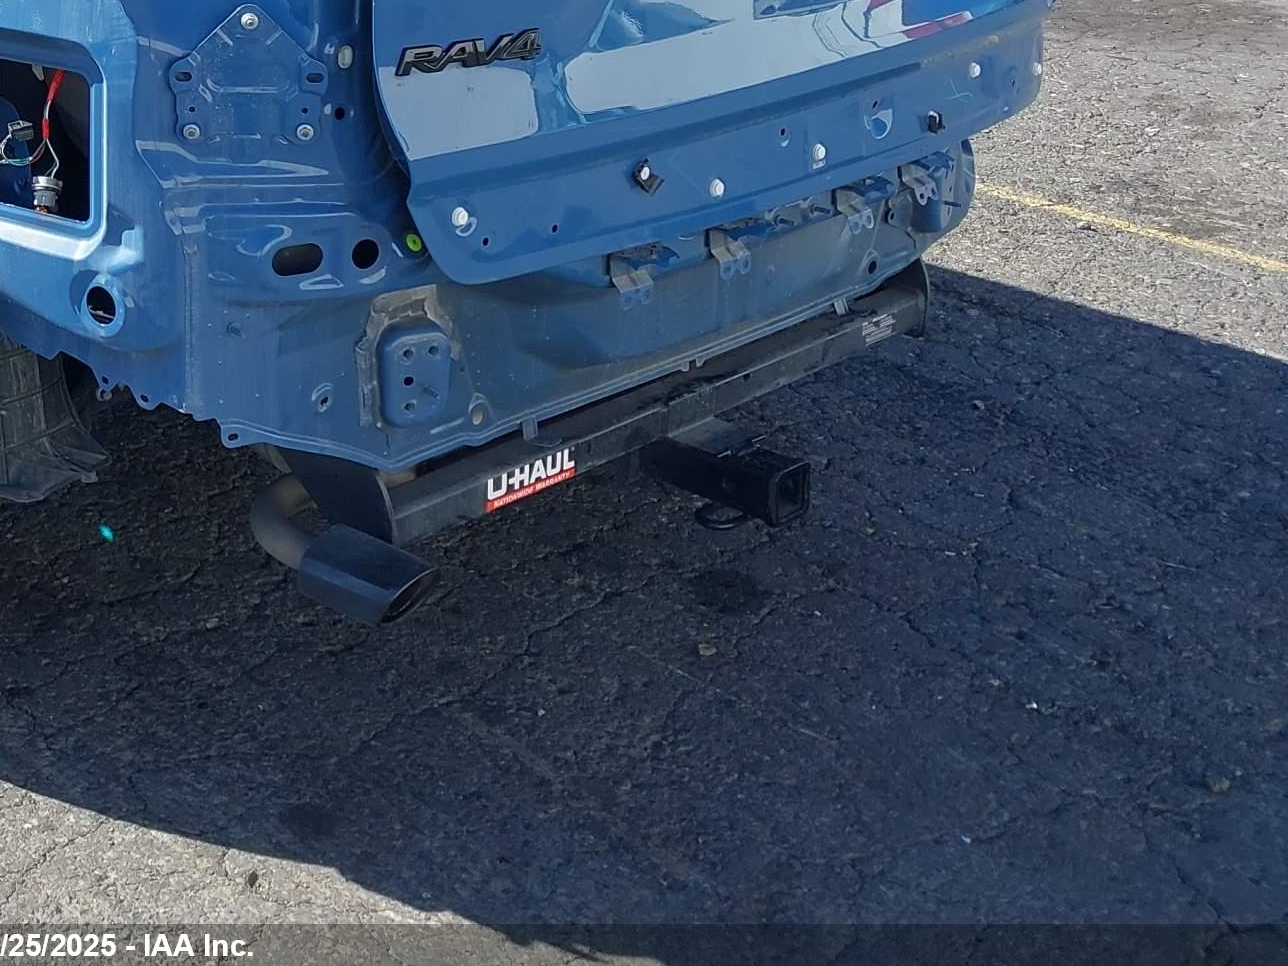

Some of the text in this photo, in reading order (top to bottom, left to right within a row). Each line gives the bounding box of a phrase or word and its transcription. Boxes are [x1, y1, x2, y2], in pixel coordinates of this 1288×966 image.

[395, 27, 543, 77] RAV4
[487, 448, 575, 501] U-HAUL
[493, 471, 571, 509] NATIONWIDE WARRANTY
